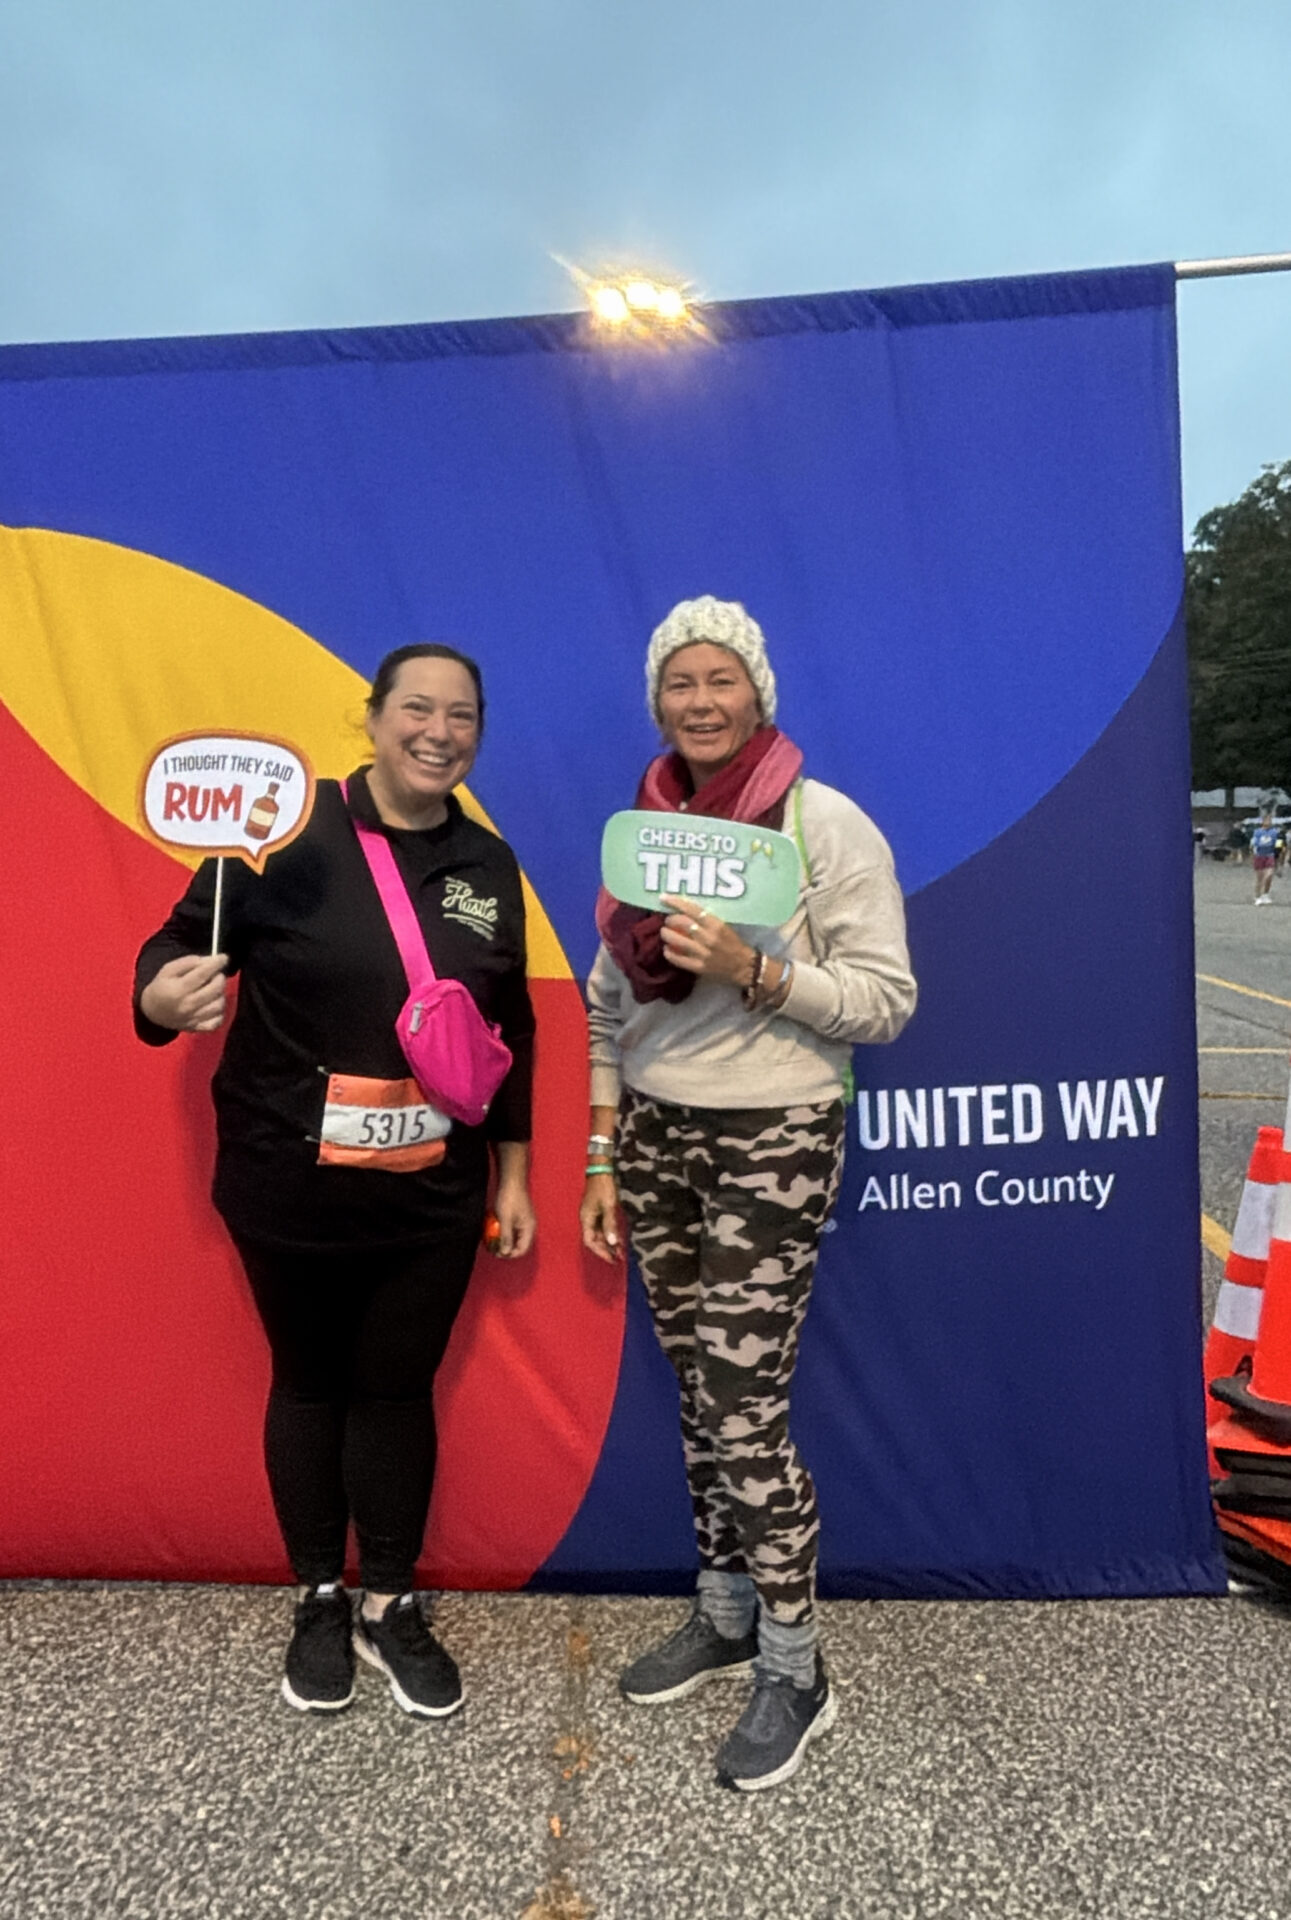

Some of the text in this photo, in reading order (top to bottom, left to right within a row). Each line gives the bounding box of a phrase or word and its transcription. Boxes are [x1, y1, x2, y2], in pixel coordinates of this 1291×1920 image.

[164, 755, 294, 782] I THOUGHT THEY SAID
[163, 782, 243, 822] RUM
[639, 828, 736, 853] CHEERS TO
[638, 852, 746, 899] THIS
[441, 876, 498, 922] Hustle
[358, 1110, 426, 1145] 5315
[858, 1076, 1165, 1151] UNITED WAY
[858, 1168, 1115, 1212] Allen County
